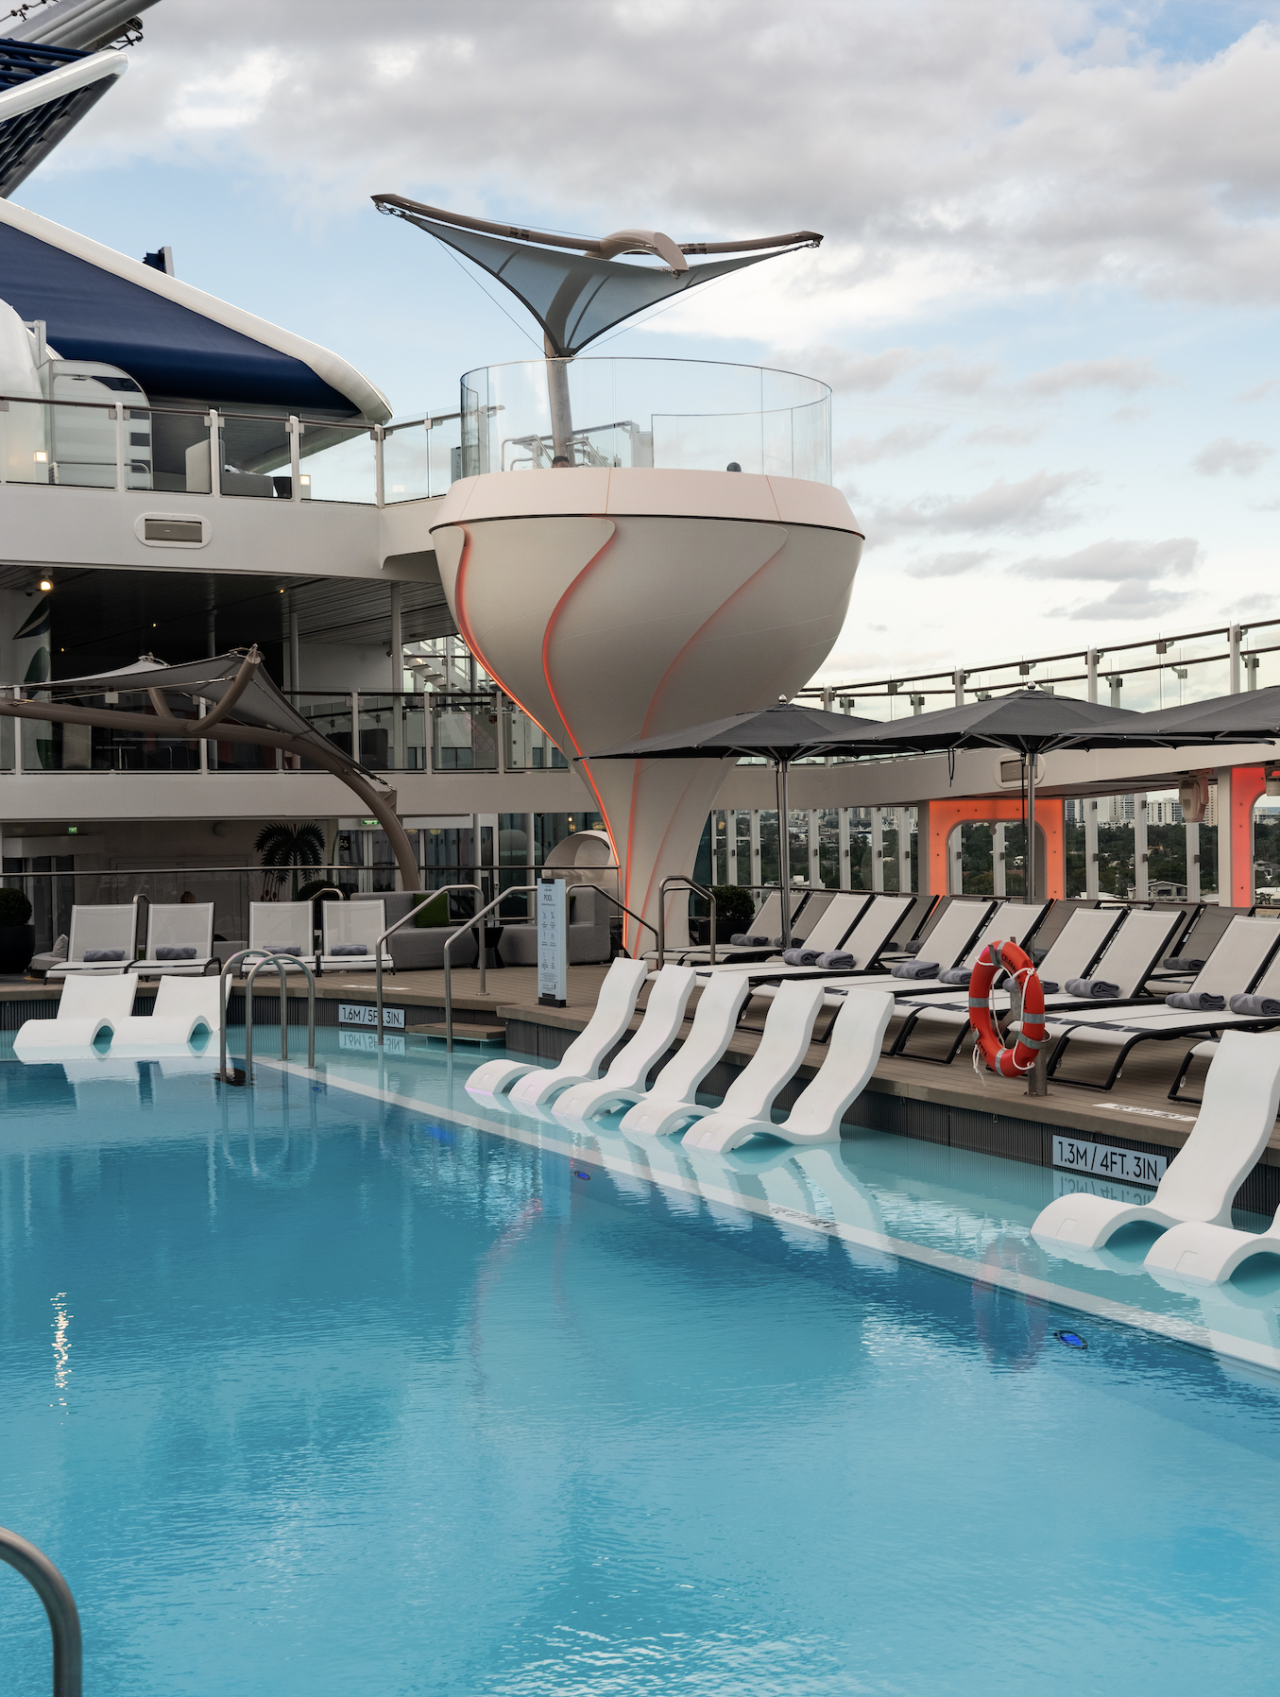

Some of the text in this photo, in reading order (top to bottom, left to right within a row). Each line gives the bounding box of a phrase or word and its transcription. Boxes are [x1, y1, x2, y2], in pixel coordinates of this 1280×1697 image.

[544, 894, 554, 902] POOL
[342, 1007, 361, 1021] 1.6M
[367, 1009, 385, 1024] 5F.
[386, 1011, 402, 1025] 3IN.
[1058, 1140, 1162, 1182] 1.3M / 4FT. 3IN.
